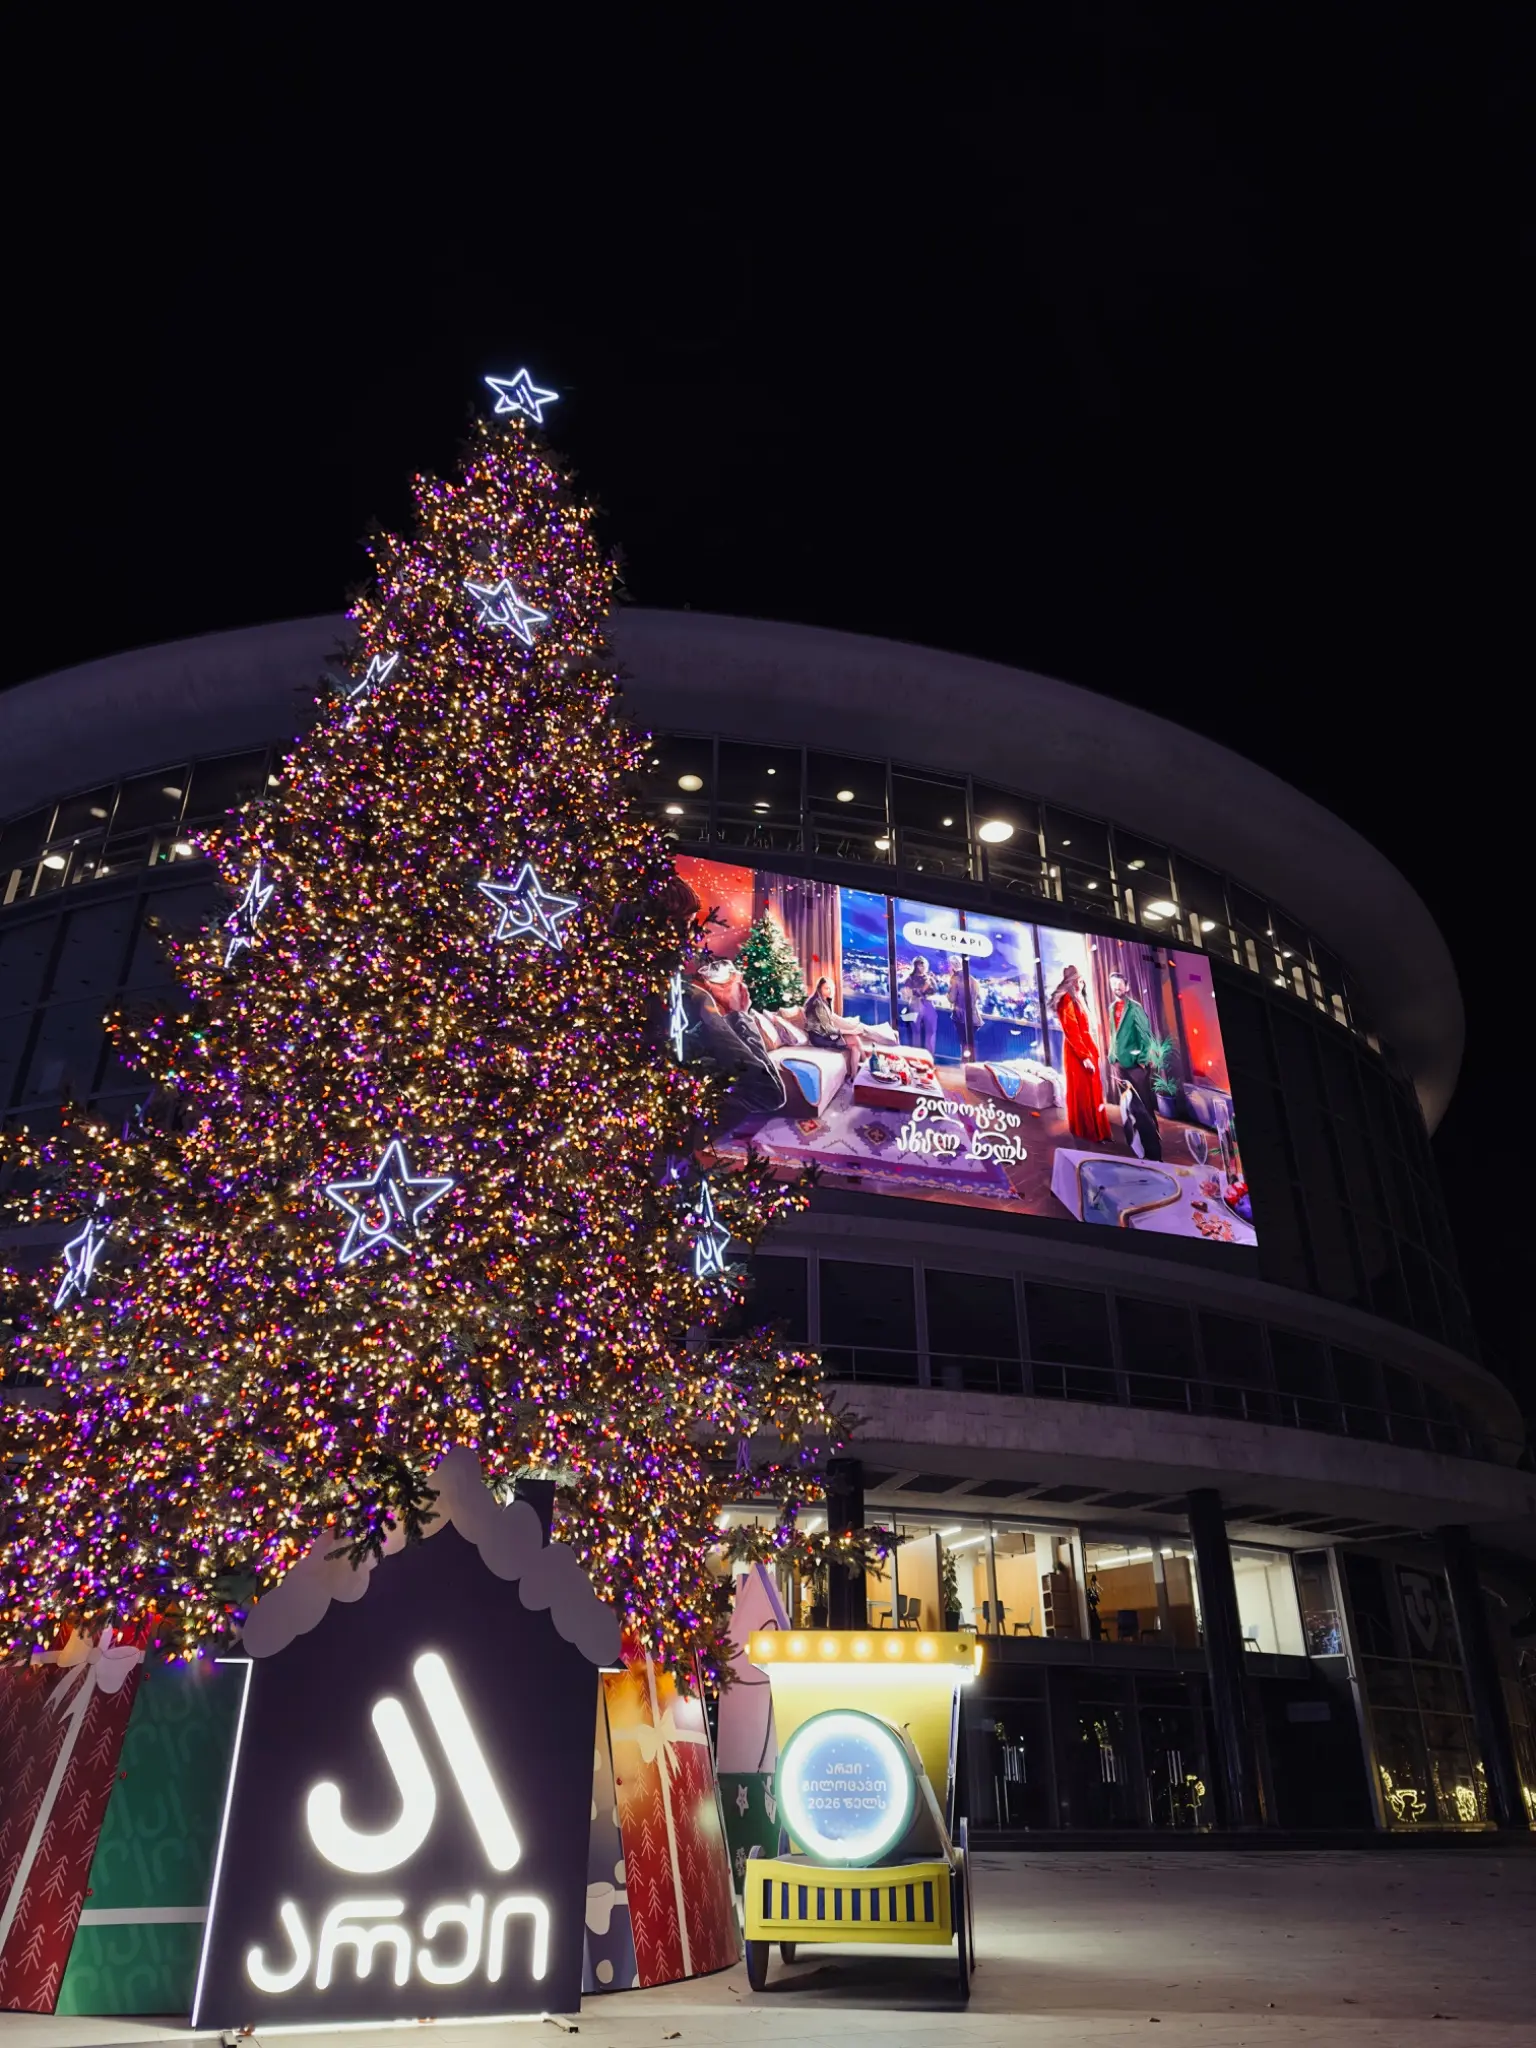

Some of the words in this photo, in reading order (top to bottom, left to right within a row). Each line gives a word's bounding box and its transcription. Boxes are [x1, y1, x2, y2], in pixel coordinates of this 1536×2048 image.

[911, 1096, 1021, 1132] გილოცავთ
[895, 1120, 961, 1158] ახალ
[964, 1129, 1028, 1166] წელს
[808, 1797, 841, 1810] 2026
[842, 1797, 886, 1810] წელს
[246, 1892, 550, 1993] არქი
